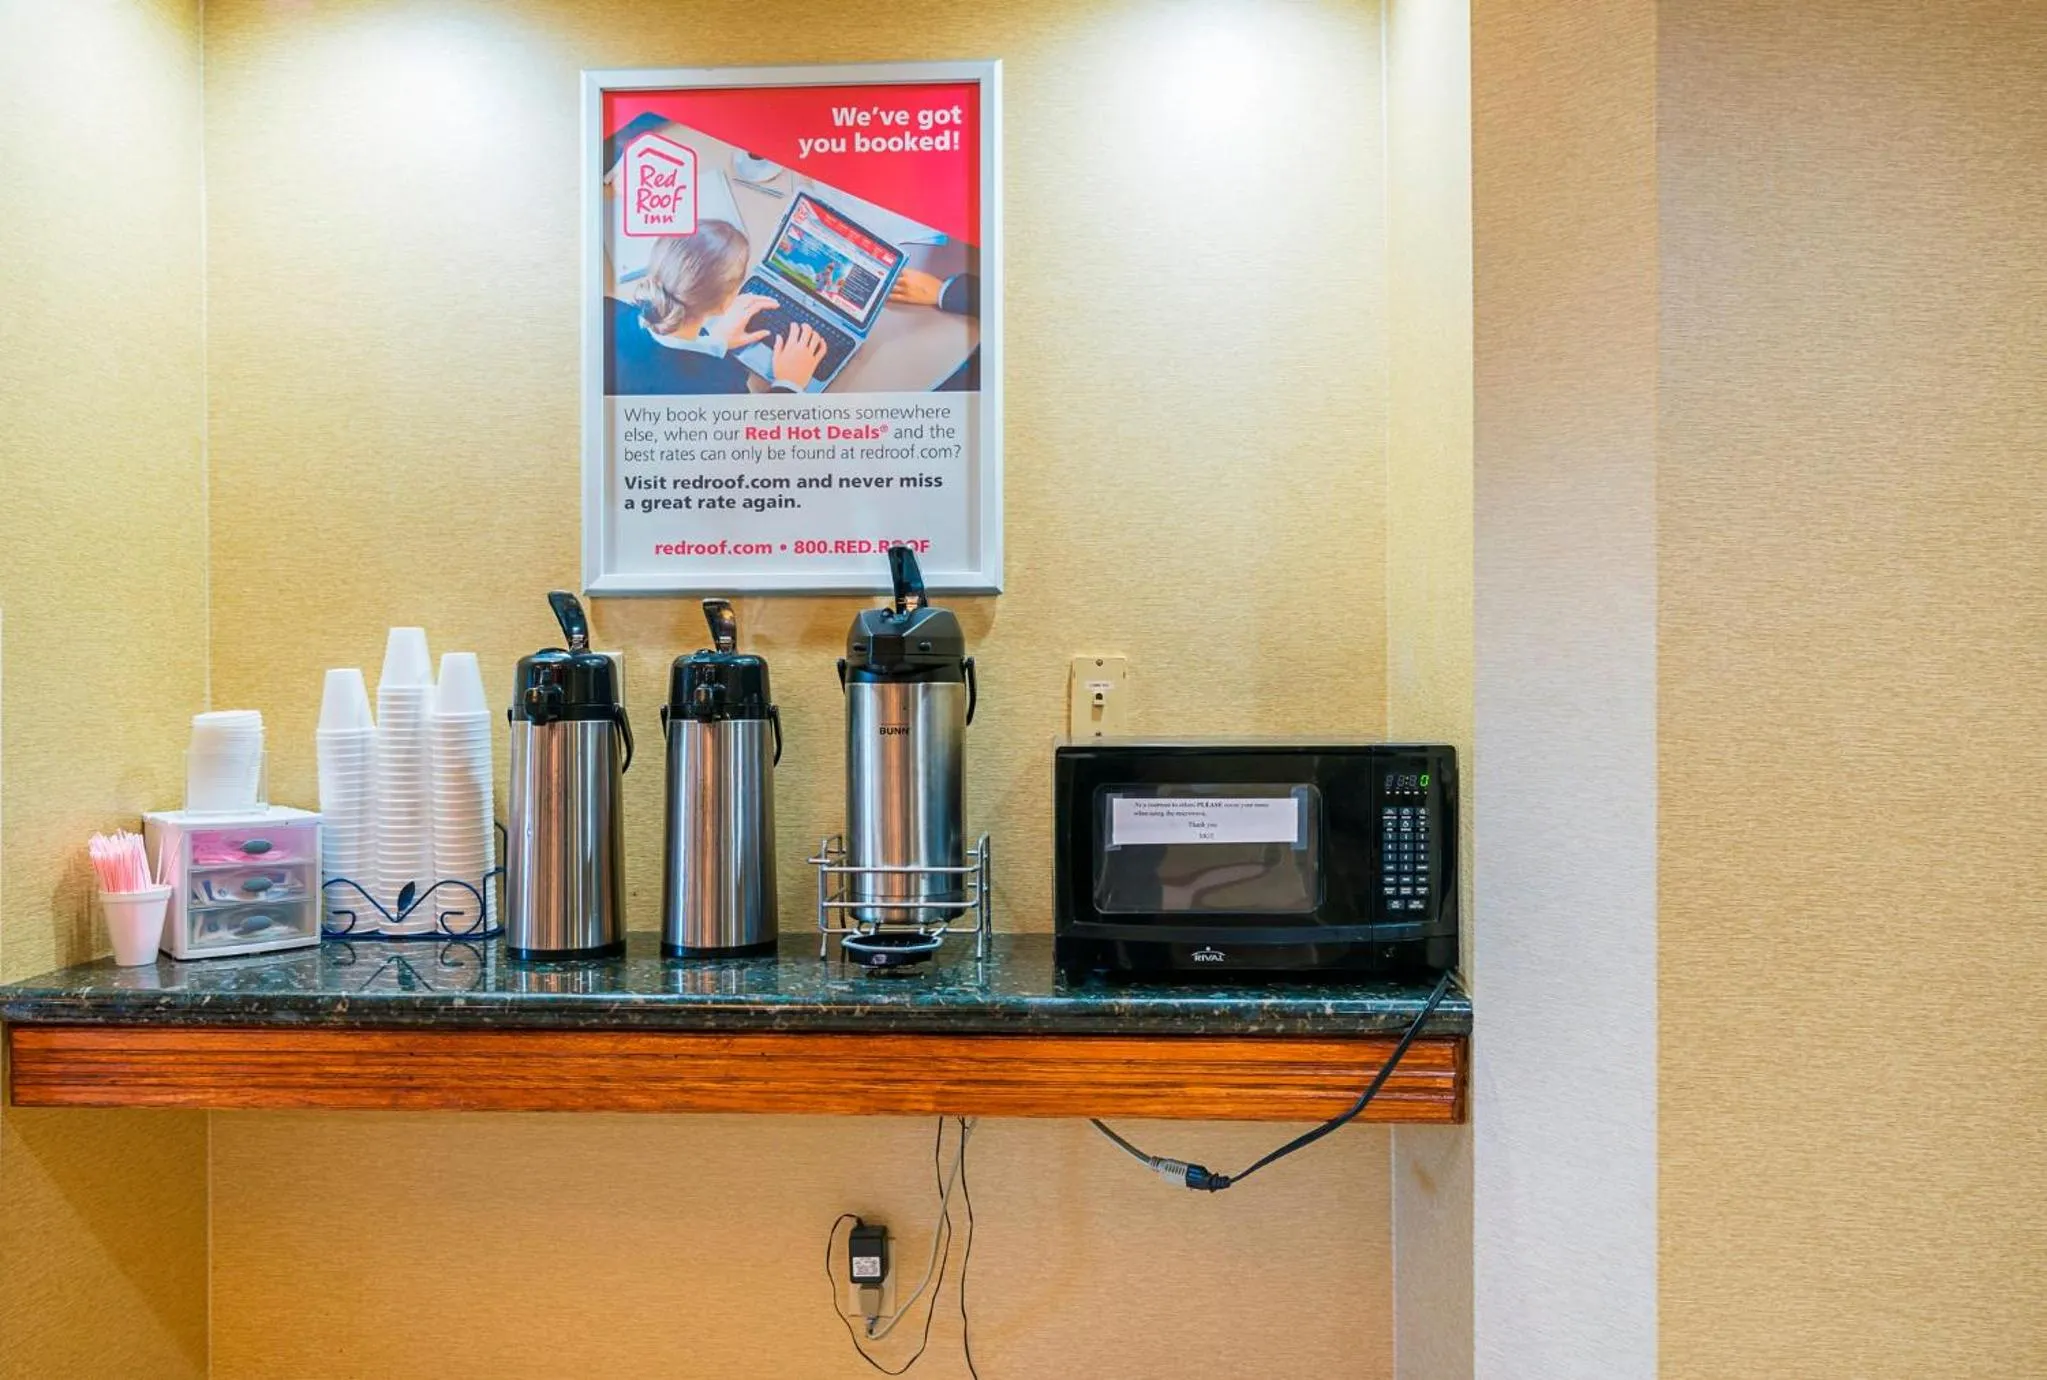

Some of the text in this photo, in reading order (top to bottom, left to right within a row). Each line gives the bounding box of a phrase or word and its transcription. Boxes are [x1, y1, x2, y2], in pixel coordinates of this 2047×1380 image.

[832, 105, 963, 130] We've got
[798, 130, 960, 159] you booked!
[640, 164, 678, 189] Red
[636, 185, 687, 214] Roof
[624, 404, 951, 425] Why book your reservations somewhere
[624, 427, 658, 443] else,
[664, 427, 708, 441] when
[713, 430, 740, 441] our
[745, 425, 781, 441] Red
[788, 425, 821, 440] Hot
[894, 424, 924, 439] and
[930, 424, 955, 439] the
[624, 444, 962, 464] best rates can only be found at redroof.com?
[624, 473, 943, 490] Visit redroof.com and never miss
[624, 494, 802, 513] a great rate again.
[655, 539, 930, 555] redroof.com 800.RED.ROF
[879, 726, 910, 736] BUNN
[1194, 954, 1225, 962] RIVAL
